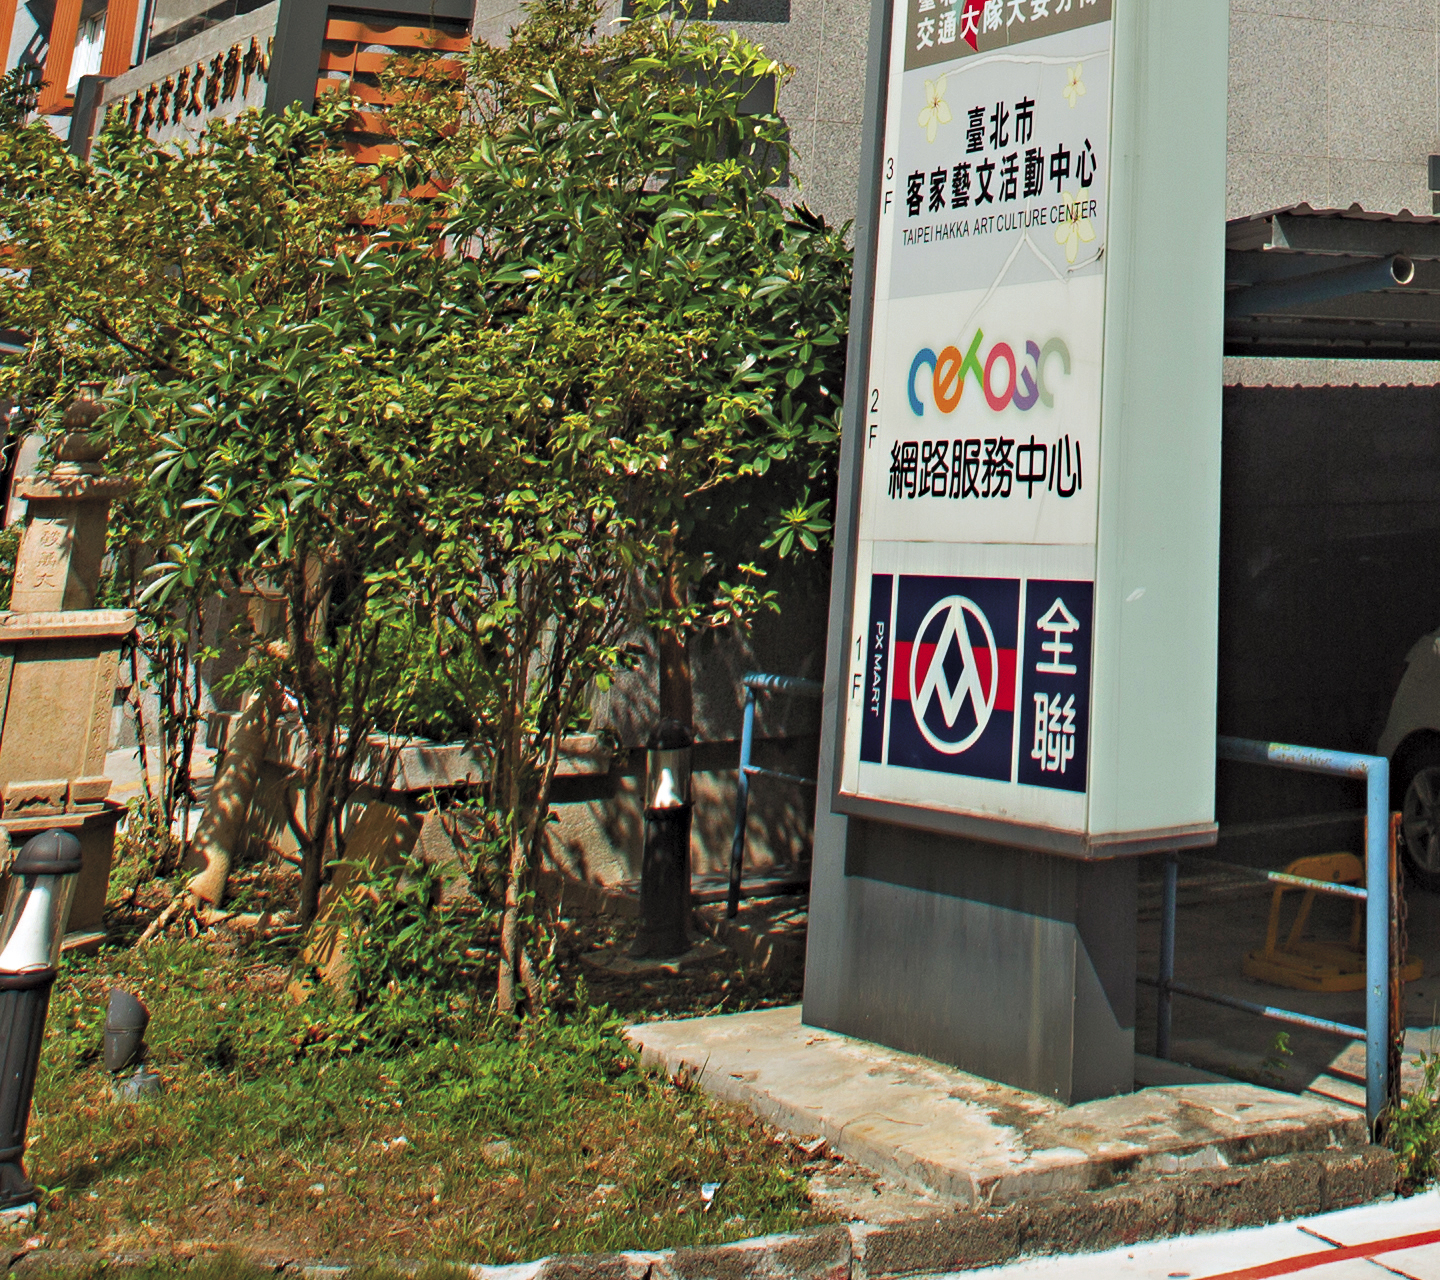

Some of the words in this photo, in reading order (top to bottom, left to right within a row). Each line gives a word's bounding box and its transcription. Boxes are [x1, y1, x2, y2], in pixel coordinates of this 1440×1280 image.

[965, 96, 1036, 155] 臺北市
[905, 137, 1098, 218] 客家藝文活動中心
[902, 225, 933, 246] TAIPEI
[935, 220, 970, 242] HAKKA
[973, 216, 995, 236] ART
[996, 207, 1048, 232] CULTURE
[1049, 199, 1098, 223] CENTER
[888, 433, 1083, 500] 網路服務中心
[874, 621, 885, 650] PX
[870, 653, 883, 718] MART
[1030, 596, 1081, 775] 全聯
